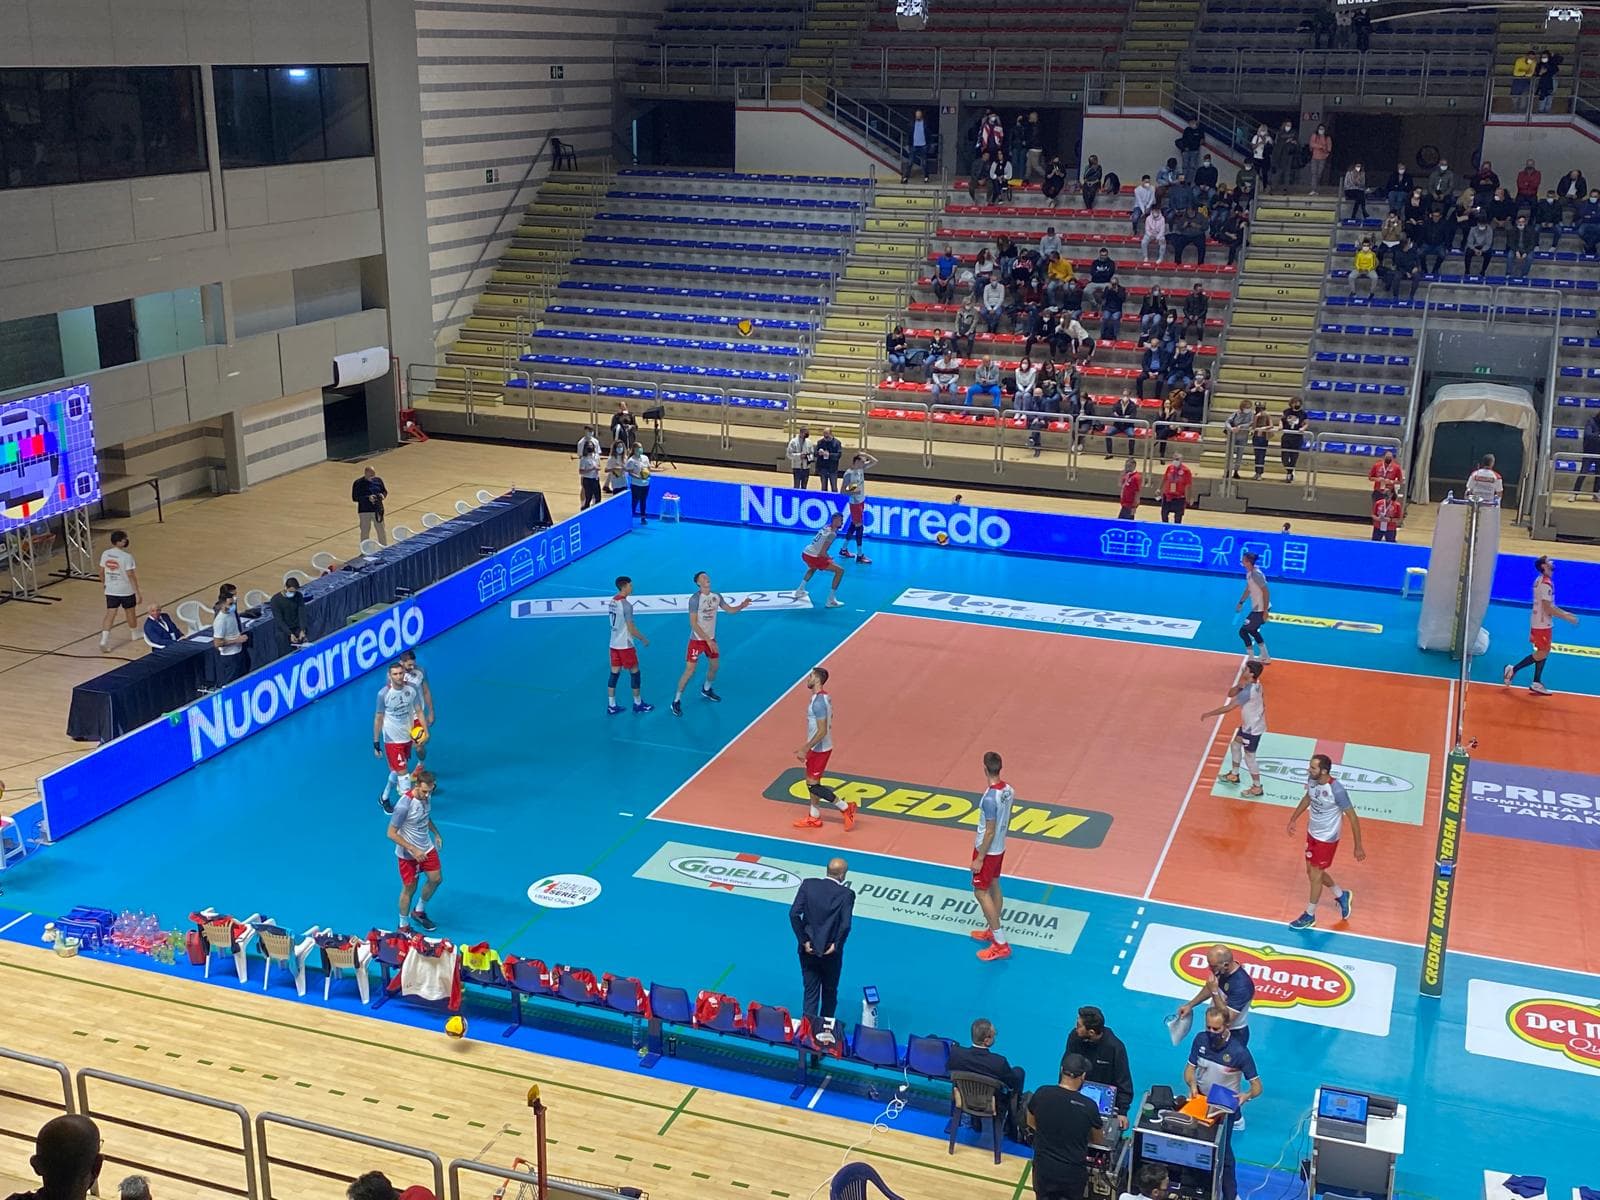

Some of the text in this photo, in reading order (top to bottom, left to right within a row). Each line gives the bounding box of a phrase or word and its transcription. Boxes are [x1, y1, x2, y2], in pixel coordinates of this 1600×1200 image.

[187, 605, 424, 762] Nuovarredo
[1447, 763, 1466, 814] BANCA
[1472, 780, 1600, 810] PRIS
[677, 859, 789, 883] GIOIELLA
[858, 883, 934, 908] PUGLIA
[940, 897, 980, 915] PIÙ
[1000, 908, 1059, 930] UONA
[1432, 879, 1450, 929] BANCA
[1425, 932, 1443, 986] CREDEM
[1254, 983, 1294, 999] ality
[1524, 1012, 1579, 1036] Del
